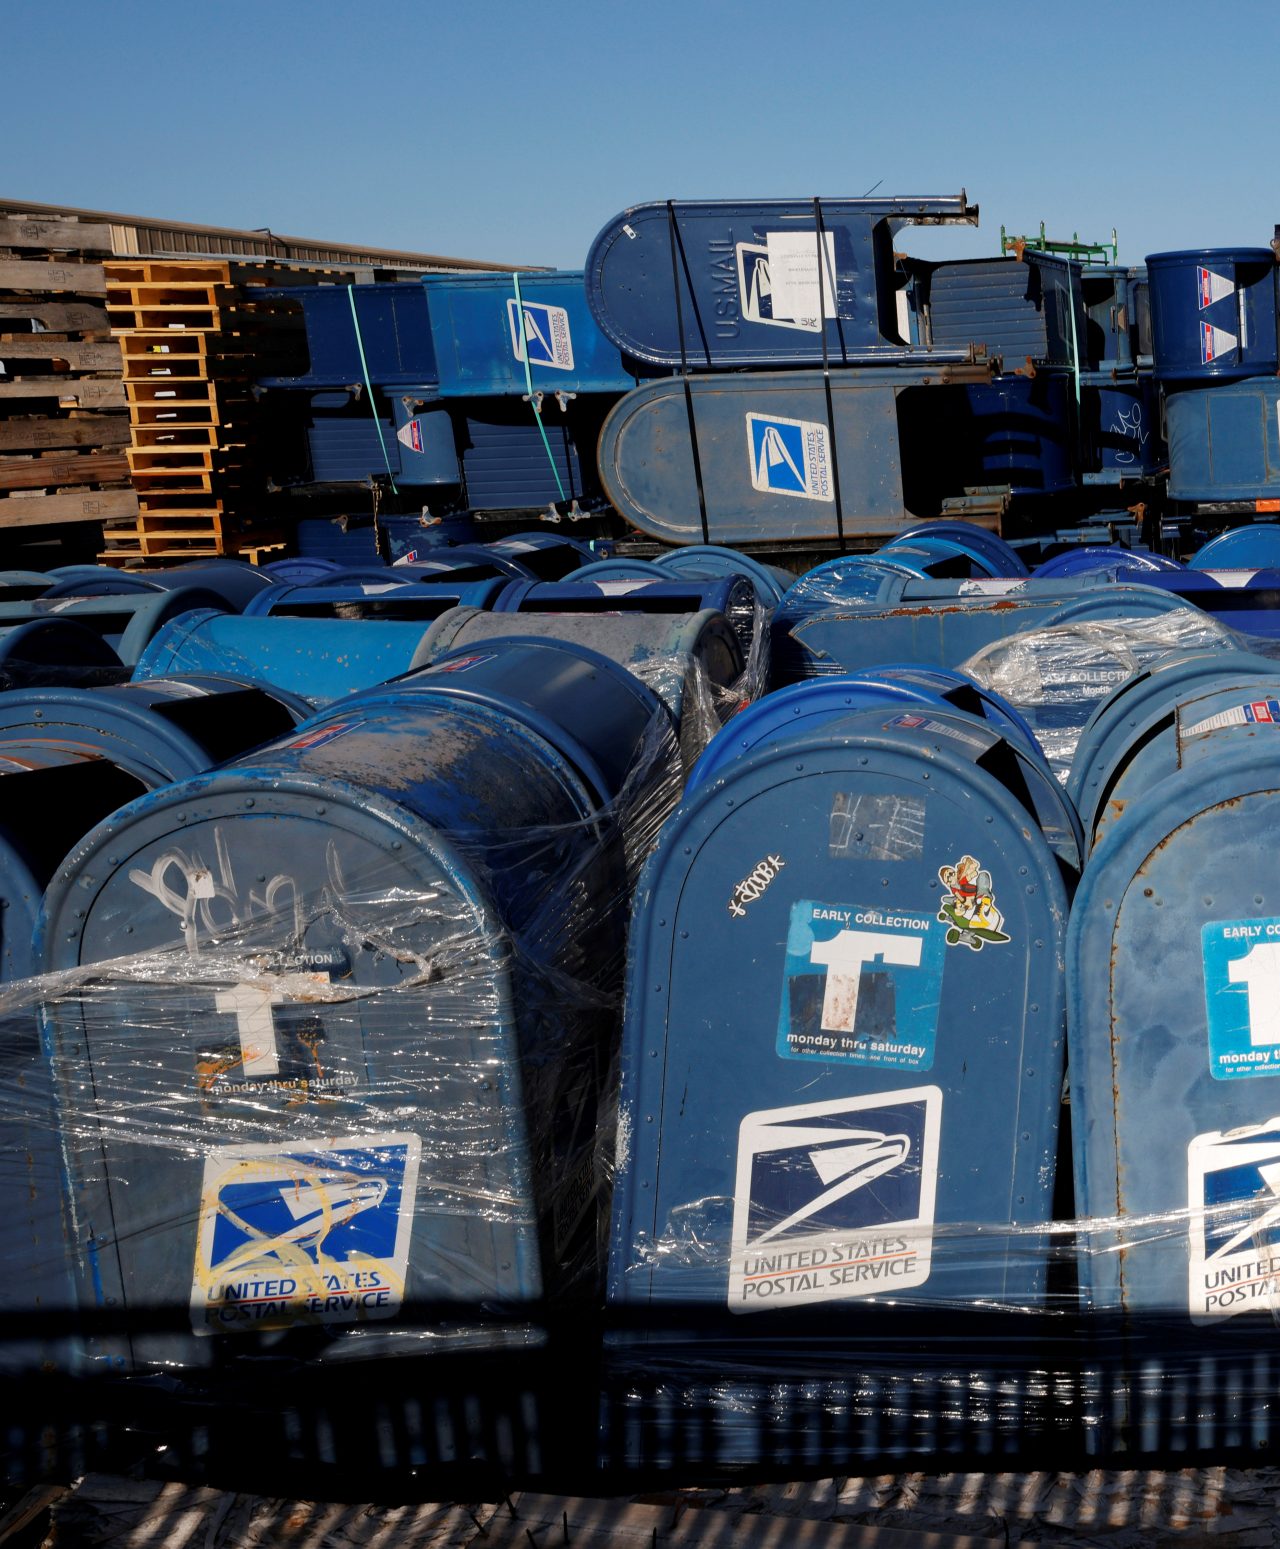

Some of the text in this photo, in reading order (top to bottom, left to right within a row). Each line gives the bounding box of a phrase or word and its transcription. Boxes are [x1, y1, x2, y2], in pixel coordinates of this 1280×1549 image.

[552, 314, 564, 365] UNITED STATES
[559, 312, 570, 365] POSTAL SERVICE
[807, 432, 819, 495] UNITED STATES
[816, 429, 828, 496] POSTAL SERVICE
[812, 909, 930, 930] EARLY COLLECTION
[1223, 926, 1262, 938] EARLY
[786, 1033, 926, 1058] monday thru saturday
[819, 1049, 847, 1057] collection
[883, 1055, 897, 1063] front
[1219, 1050, 1271, 1064] monday
[211, 1082, 265, 1095] monday
[268, 1079, 296, 1090] thru
[301, 1075, 359, 1088] saturday
[744, 1235, 908, 1276] UNITED STATES
[207, 1279, 297, 1301] UNITED
[742, 1257, 917, 1300] POSTAL SERVICE
[205, 1301, 293, 1324] POSTAL
